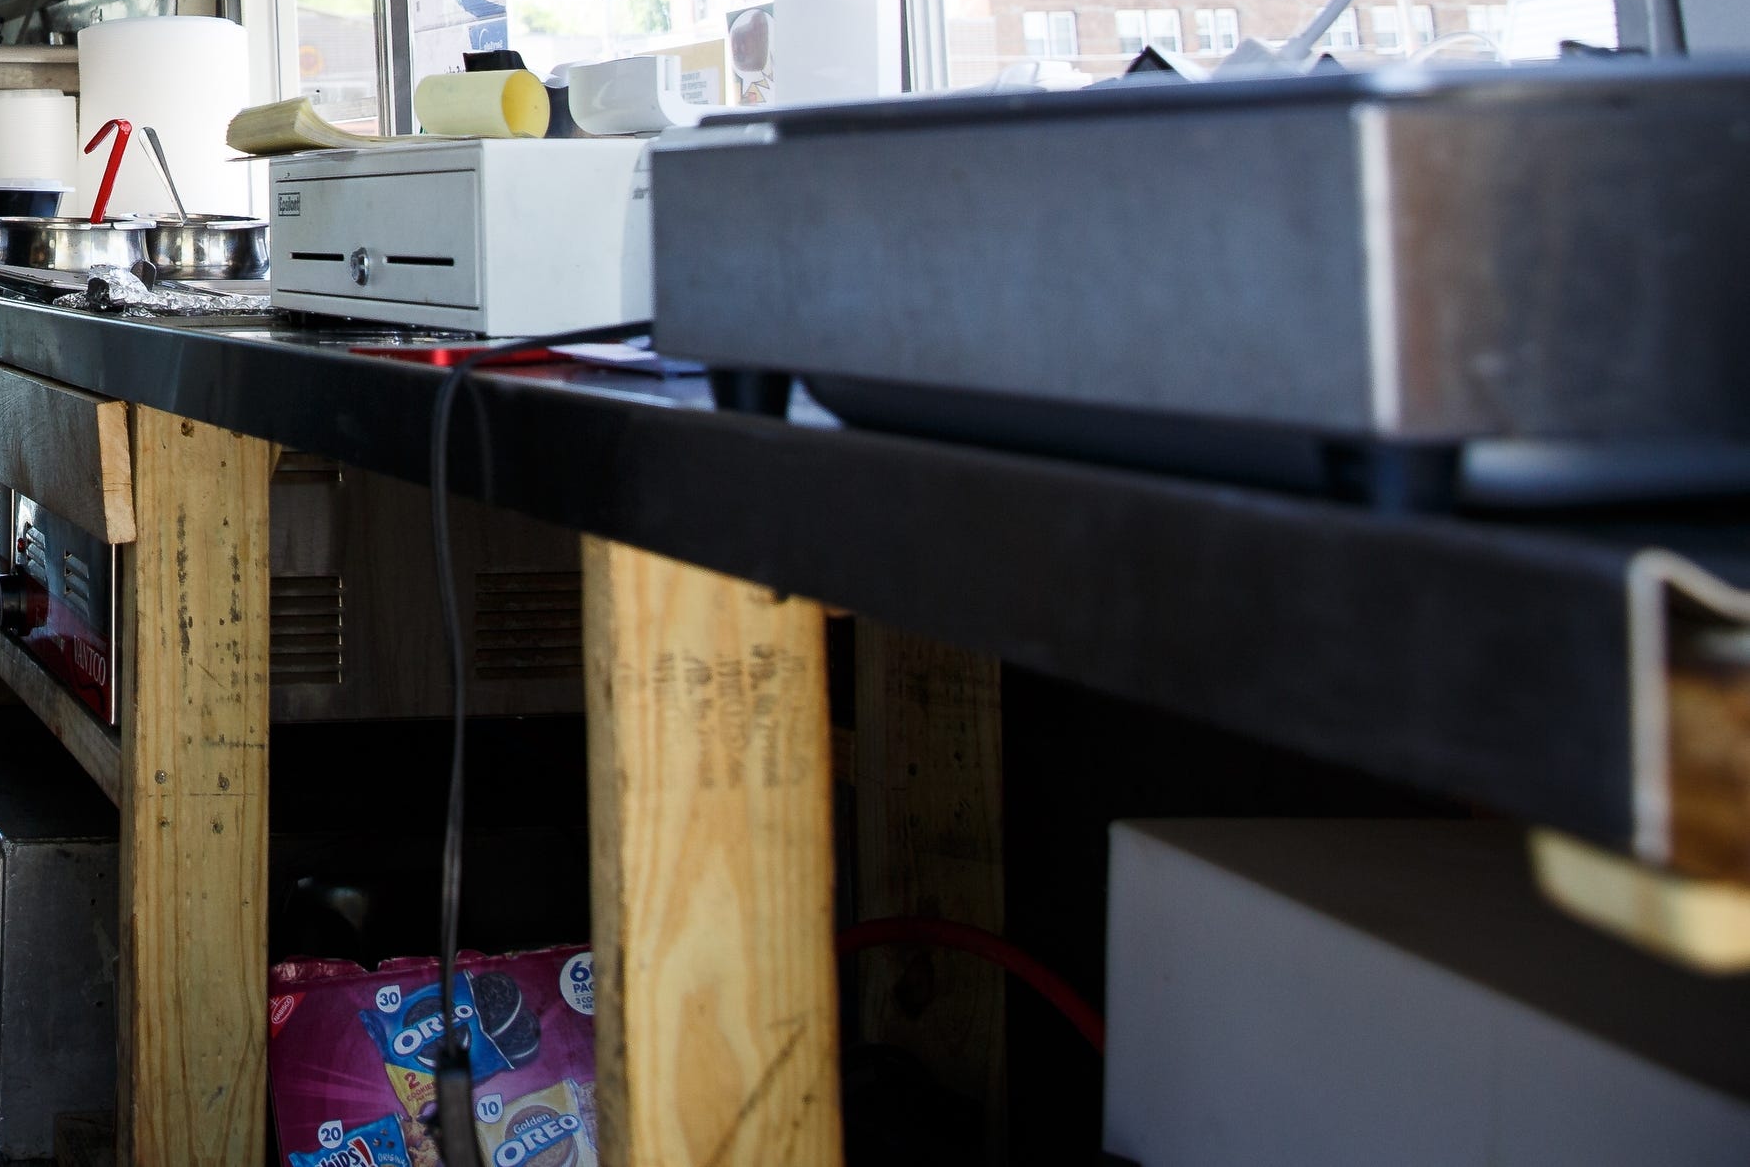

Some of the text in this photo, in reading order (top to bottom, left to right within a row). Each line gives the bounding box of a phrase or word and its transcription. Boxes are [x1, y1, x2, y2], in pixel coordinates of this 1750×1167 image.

[379, 991, 400, 1008] 30
[272, 997, 294, 1023] NABISCO
[394, 1006, 473, 1055] ORO
[406, 1072, 421, 1090] 2
[481, 1102, 499, 1116] 10
[513, 1113, 551, 1135] Golden
[321, 1127, 341, 1142] 20
[497, 1115, 578, 1165] OREO
